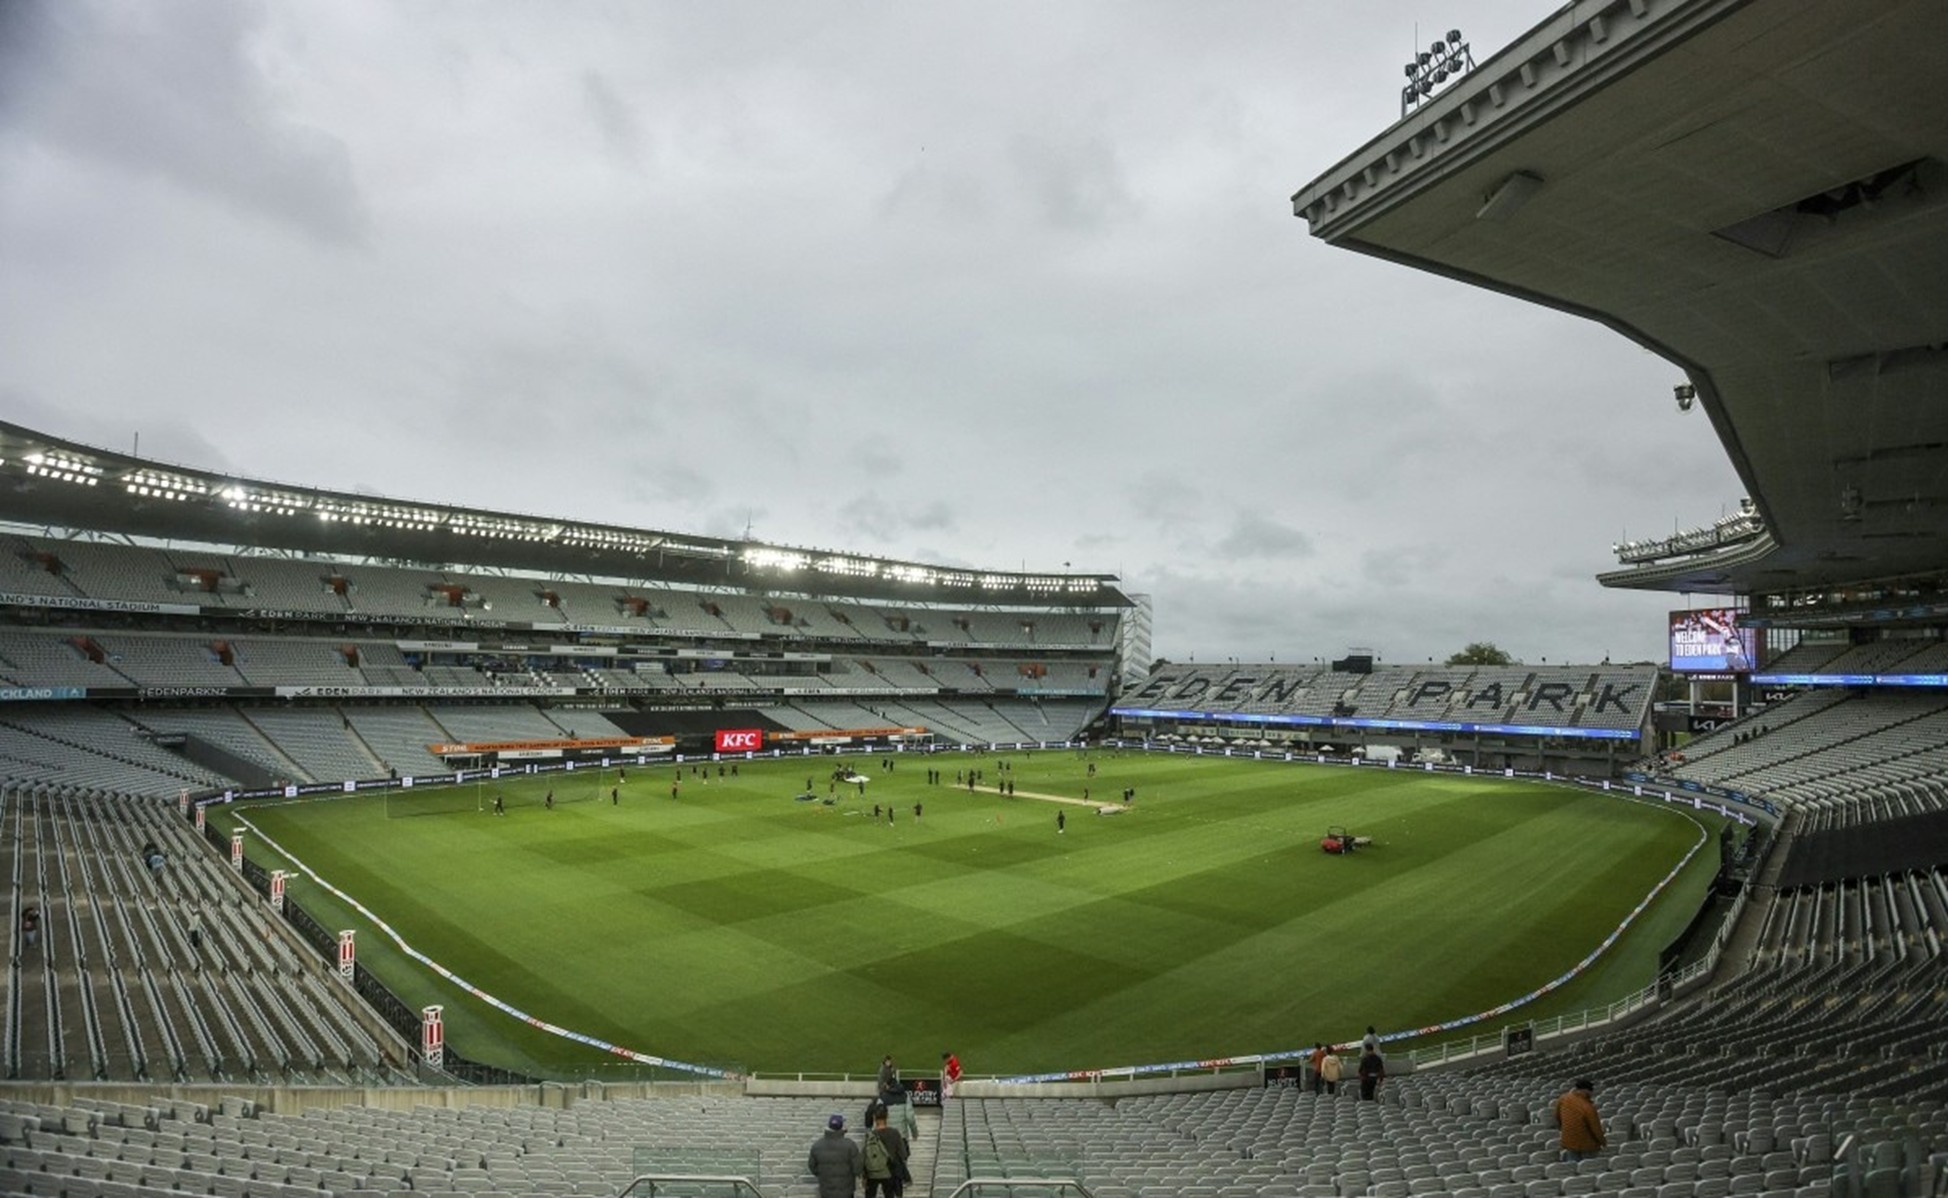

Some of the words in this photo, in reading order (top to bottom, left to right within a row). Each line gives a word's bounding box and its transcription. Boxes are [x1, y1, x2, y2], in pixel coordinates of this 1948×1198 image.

[39, 596, 100, 608] NATIONAL
[107, 602, 160, 611] STADIUM
[295, 611, 326, 620] PARK
[317, 687, 349, 696] EDEN
[1137, 677, 1303, 701] EDEN
[1407, 681, 1640, 713] PARK
[722, 733, 756, 747] KFC
